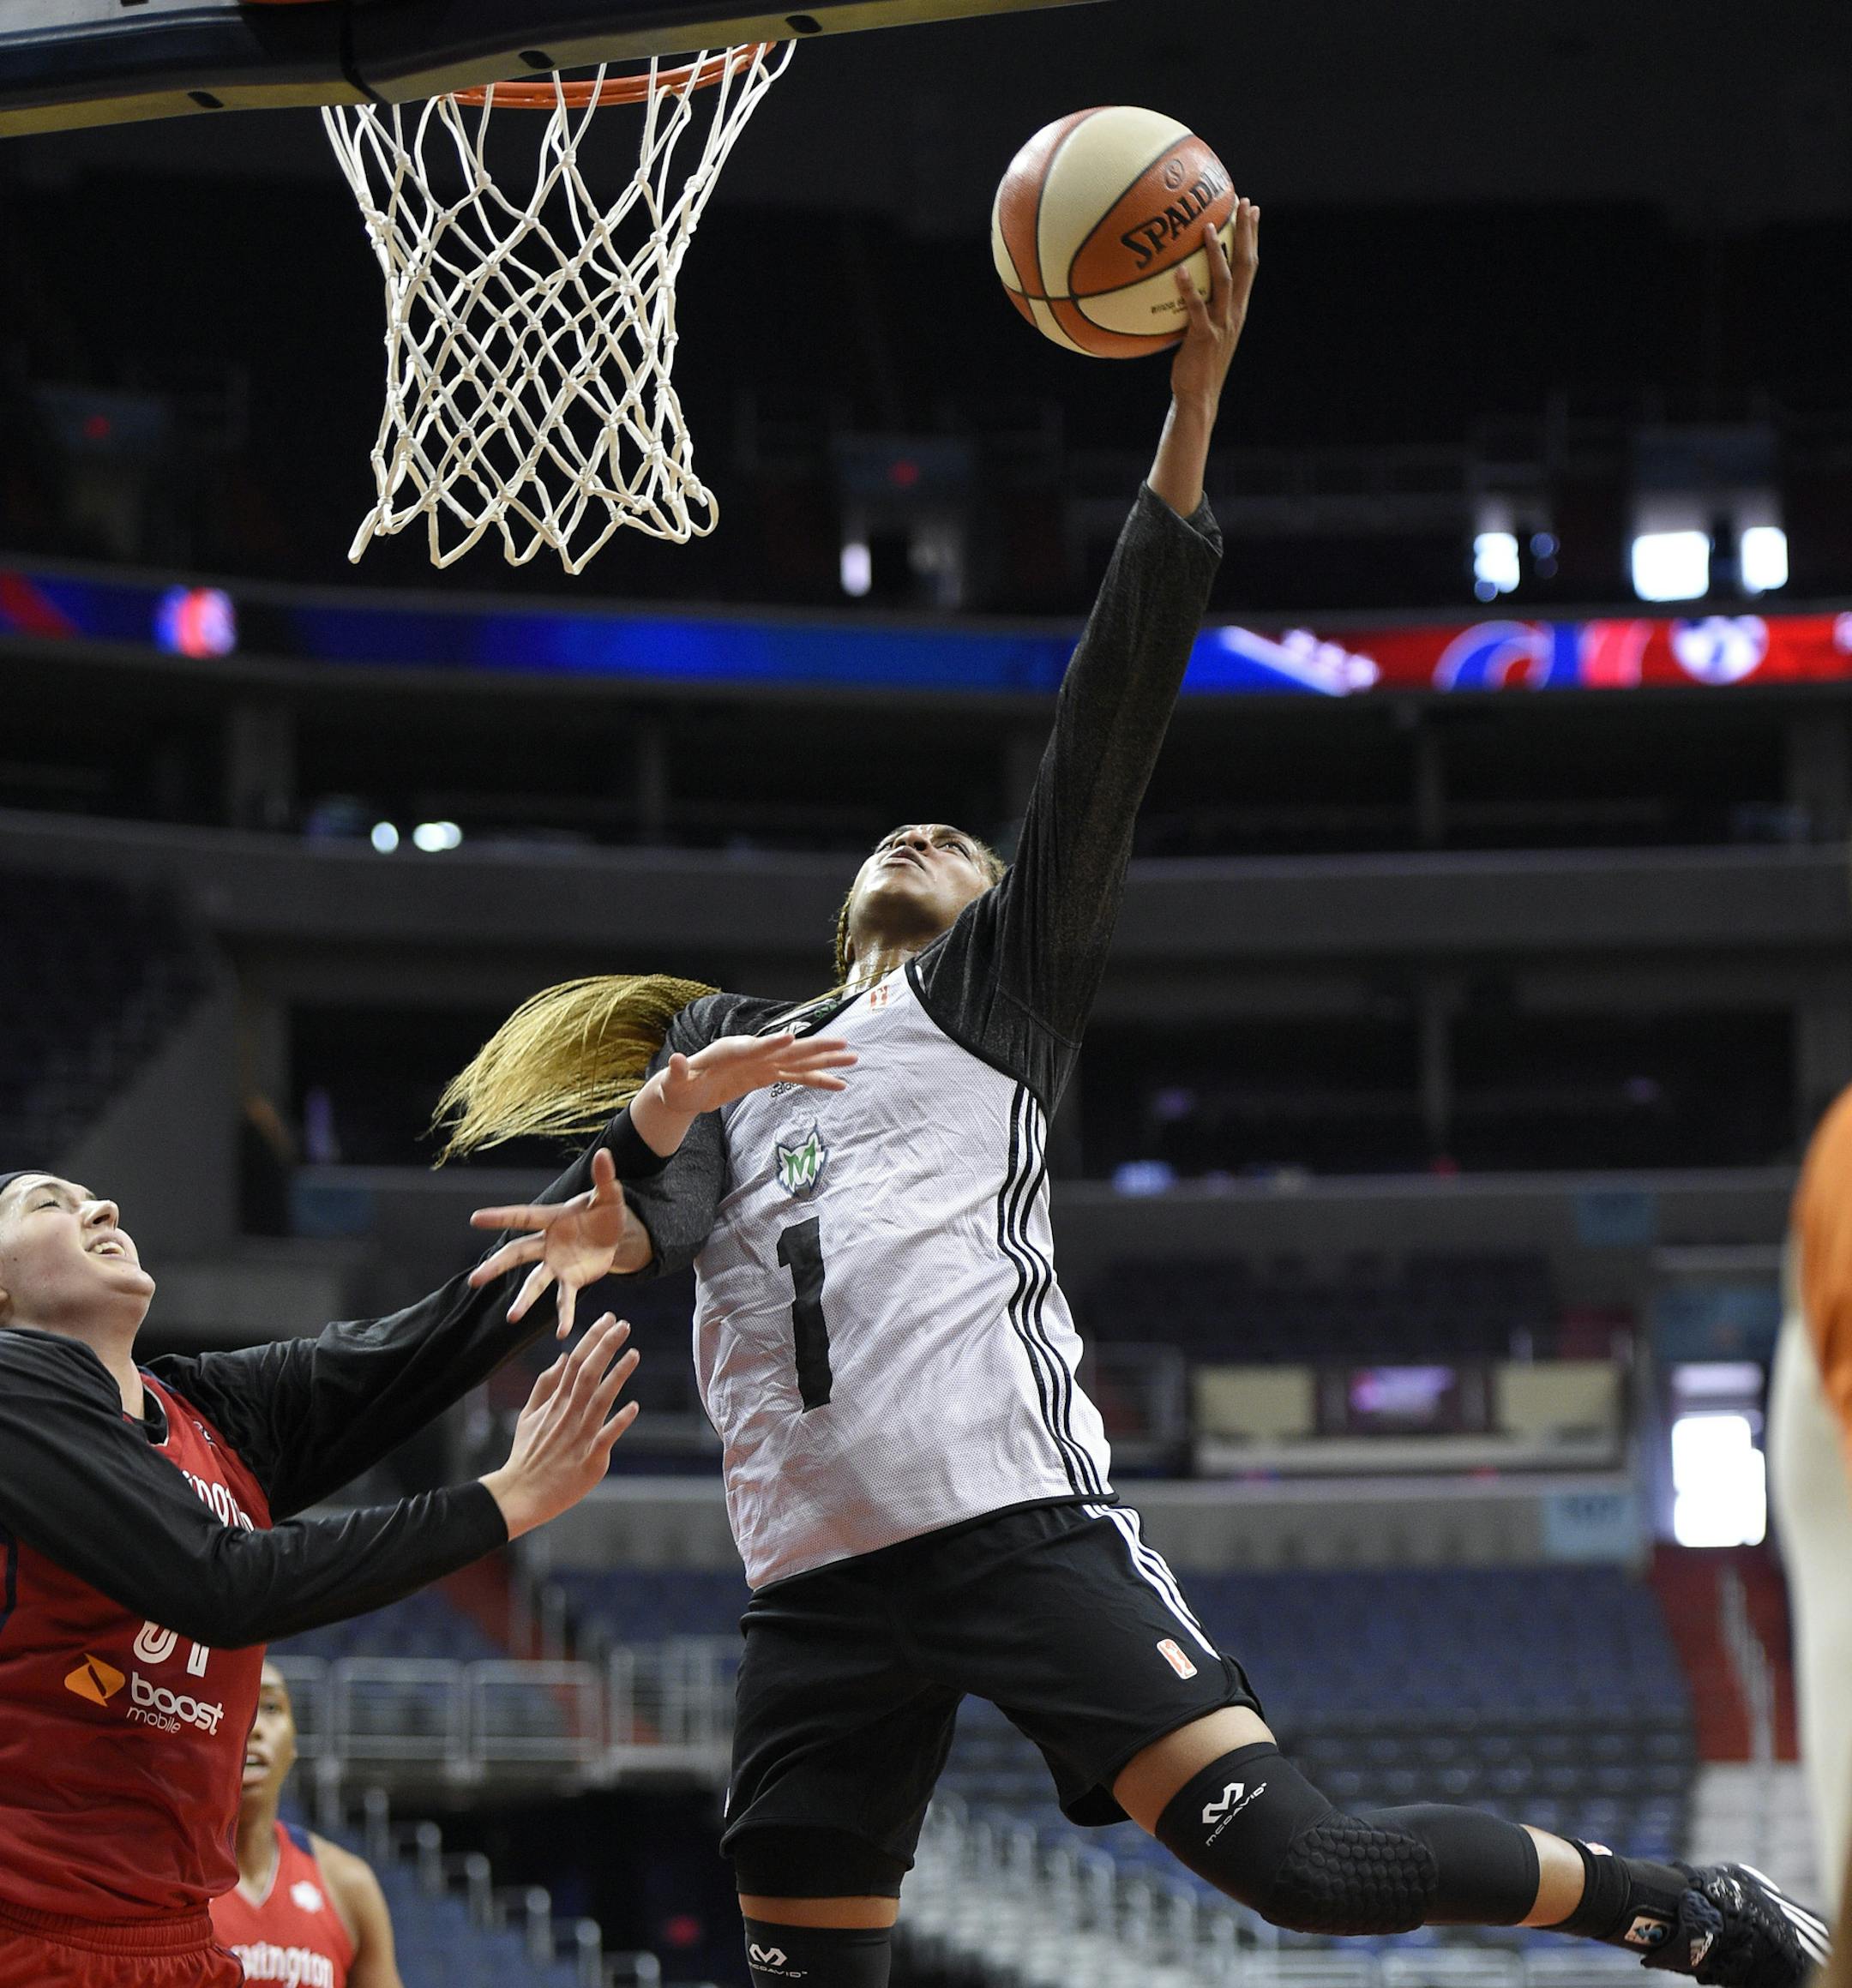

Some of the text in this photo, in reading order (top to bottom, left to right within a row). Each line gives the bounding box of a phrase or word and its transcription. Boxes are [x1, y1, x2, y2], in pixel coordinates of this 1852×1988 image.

[776, 1216, 831, 1414] 1
[126, 1706, 182, 1734] mobile
[131, 1671, 224, 1736] boost
